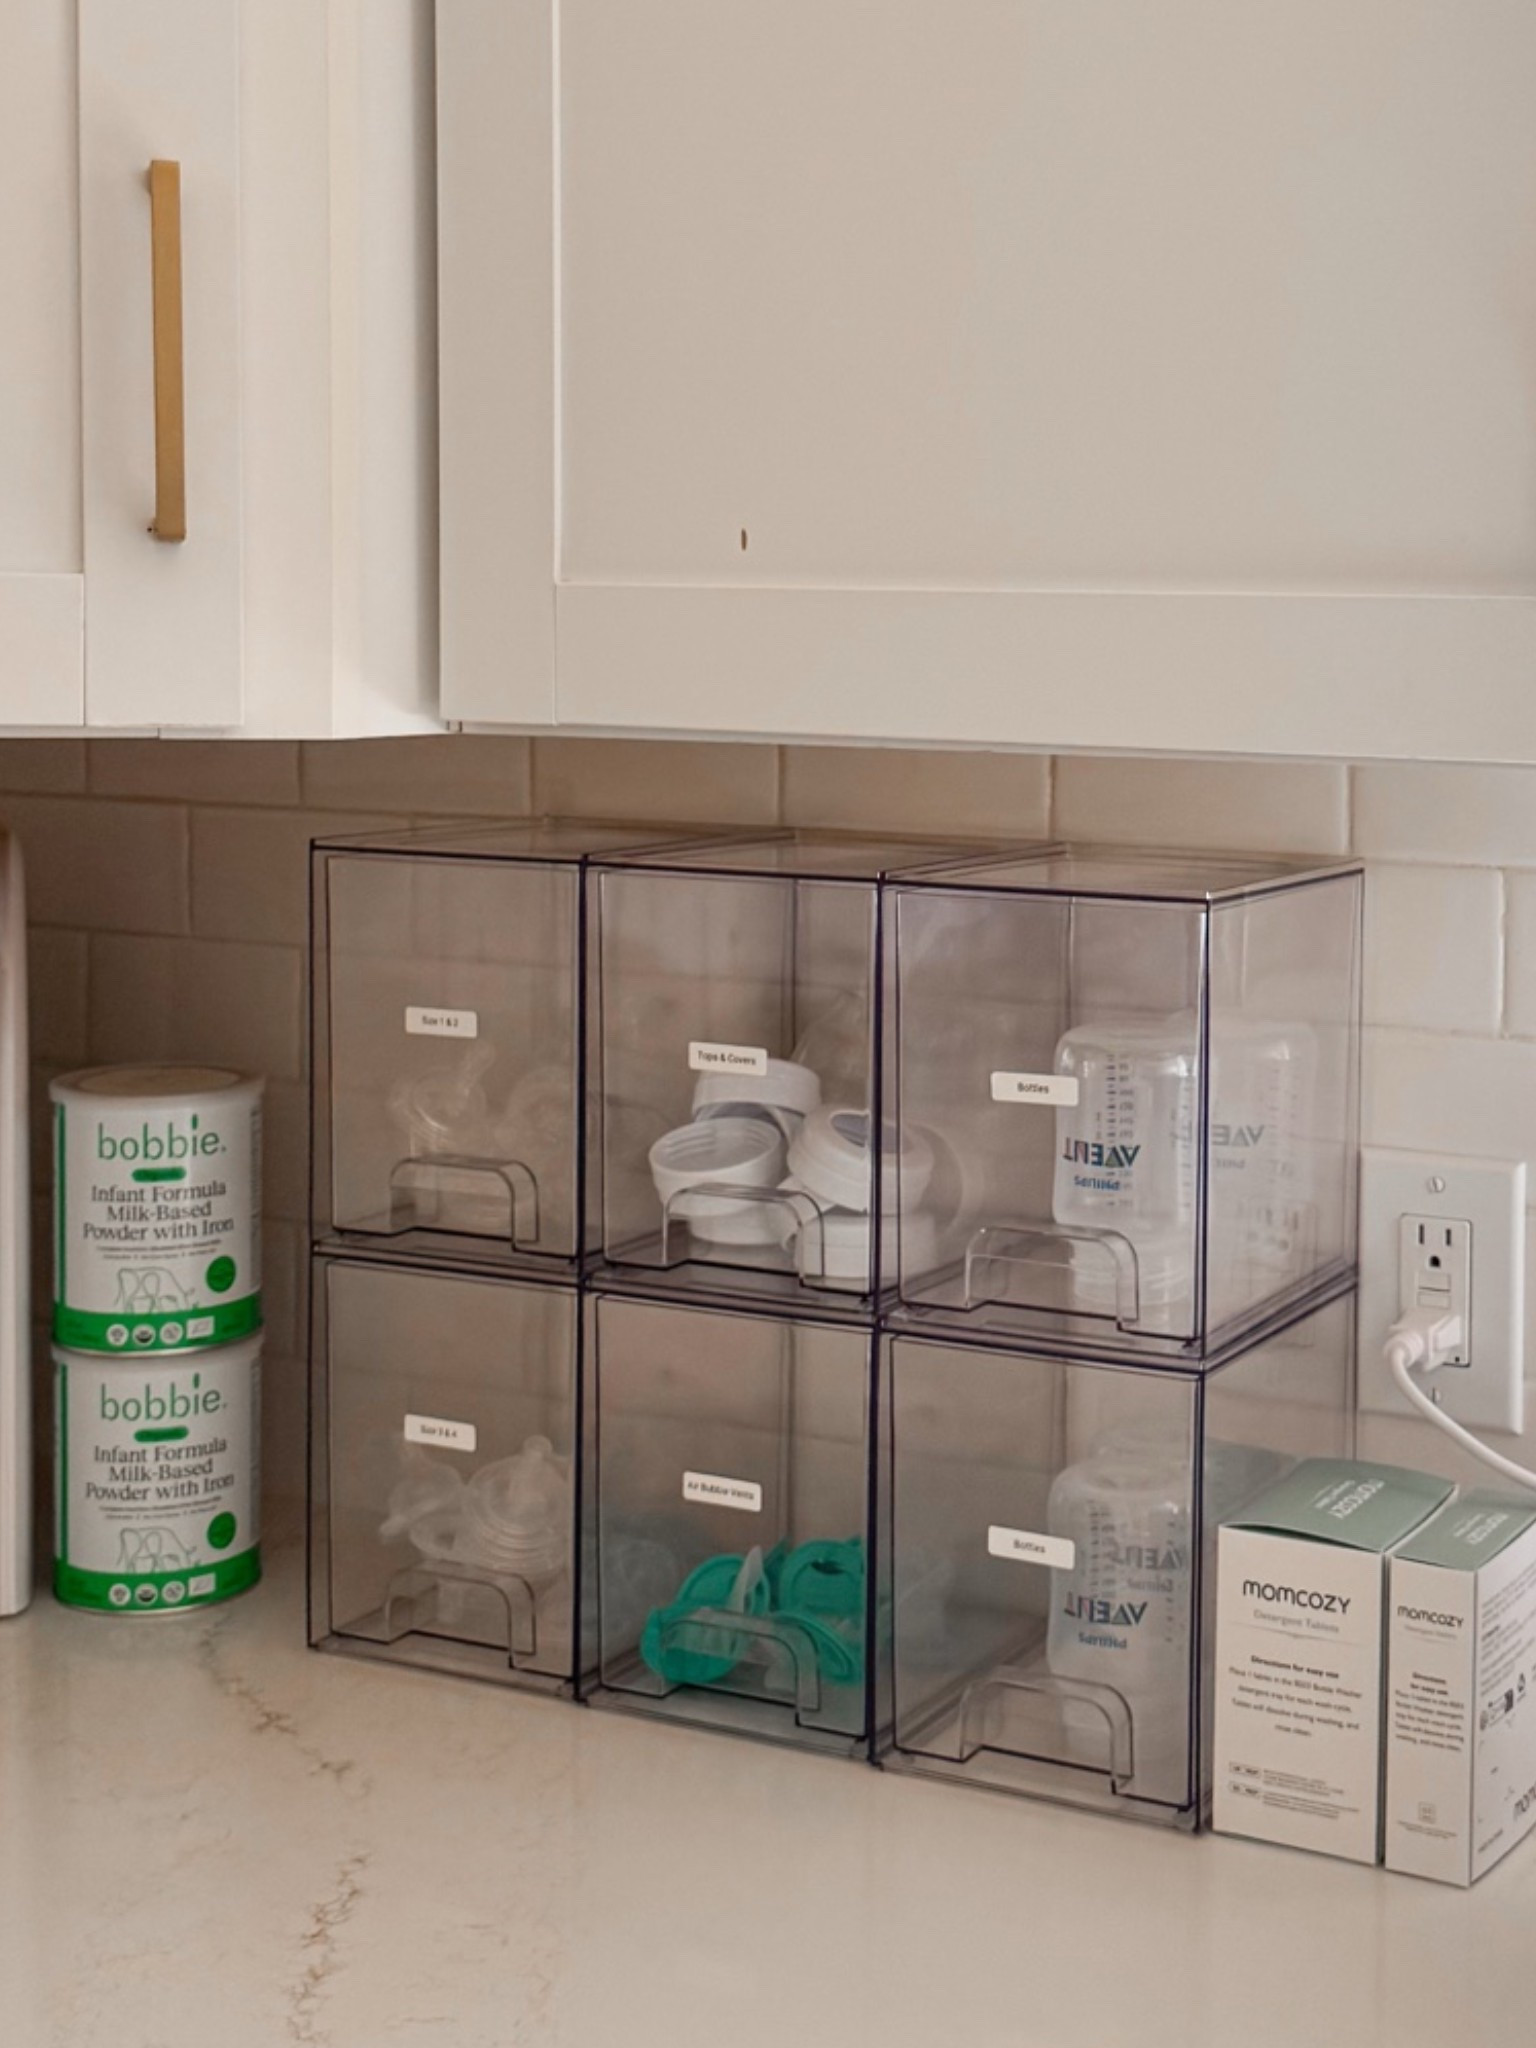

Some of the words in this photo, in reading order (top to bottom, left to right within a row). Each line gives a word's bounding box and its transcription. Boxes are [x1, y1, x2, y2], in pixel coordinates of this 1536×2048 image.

[697, 1049, 718, 1063] Tops
[720, 1052, 726, 1062] &
[727, 1052, 757, 1066] Covers
[1016, 1081, 1049, 1095] Bottles
[1062, 1136, 1141, 1168] AVENT
[91, 1184, 145, 1202] Infant
[152, 1180, 227, 1202] Formula
[1074, 1175, 1121, 1191] PHILIPS
[107, 1199, 212, 1222] Milk-Based
[83, 1221, 148, 1241] Powder
[153, 1220, 198, 1239] with
[202, 1217, 235, 1237] Iron
[94, 1444, 147, 1463] Infant
[154, 1437, 227, 1462] Formula
[109, 1458, 213, 1482] Milk-Based
[85, 1481, 151, 1501] Powder
[155, 1479, 200, 1499] with
[203, 1474, 235, 1494] Iron
[1013, 1538, 1046, 1554] Bottles
[1063, 1590, 1148, 1626] AVENT
